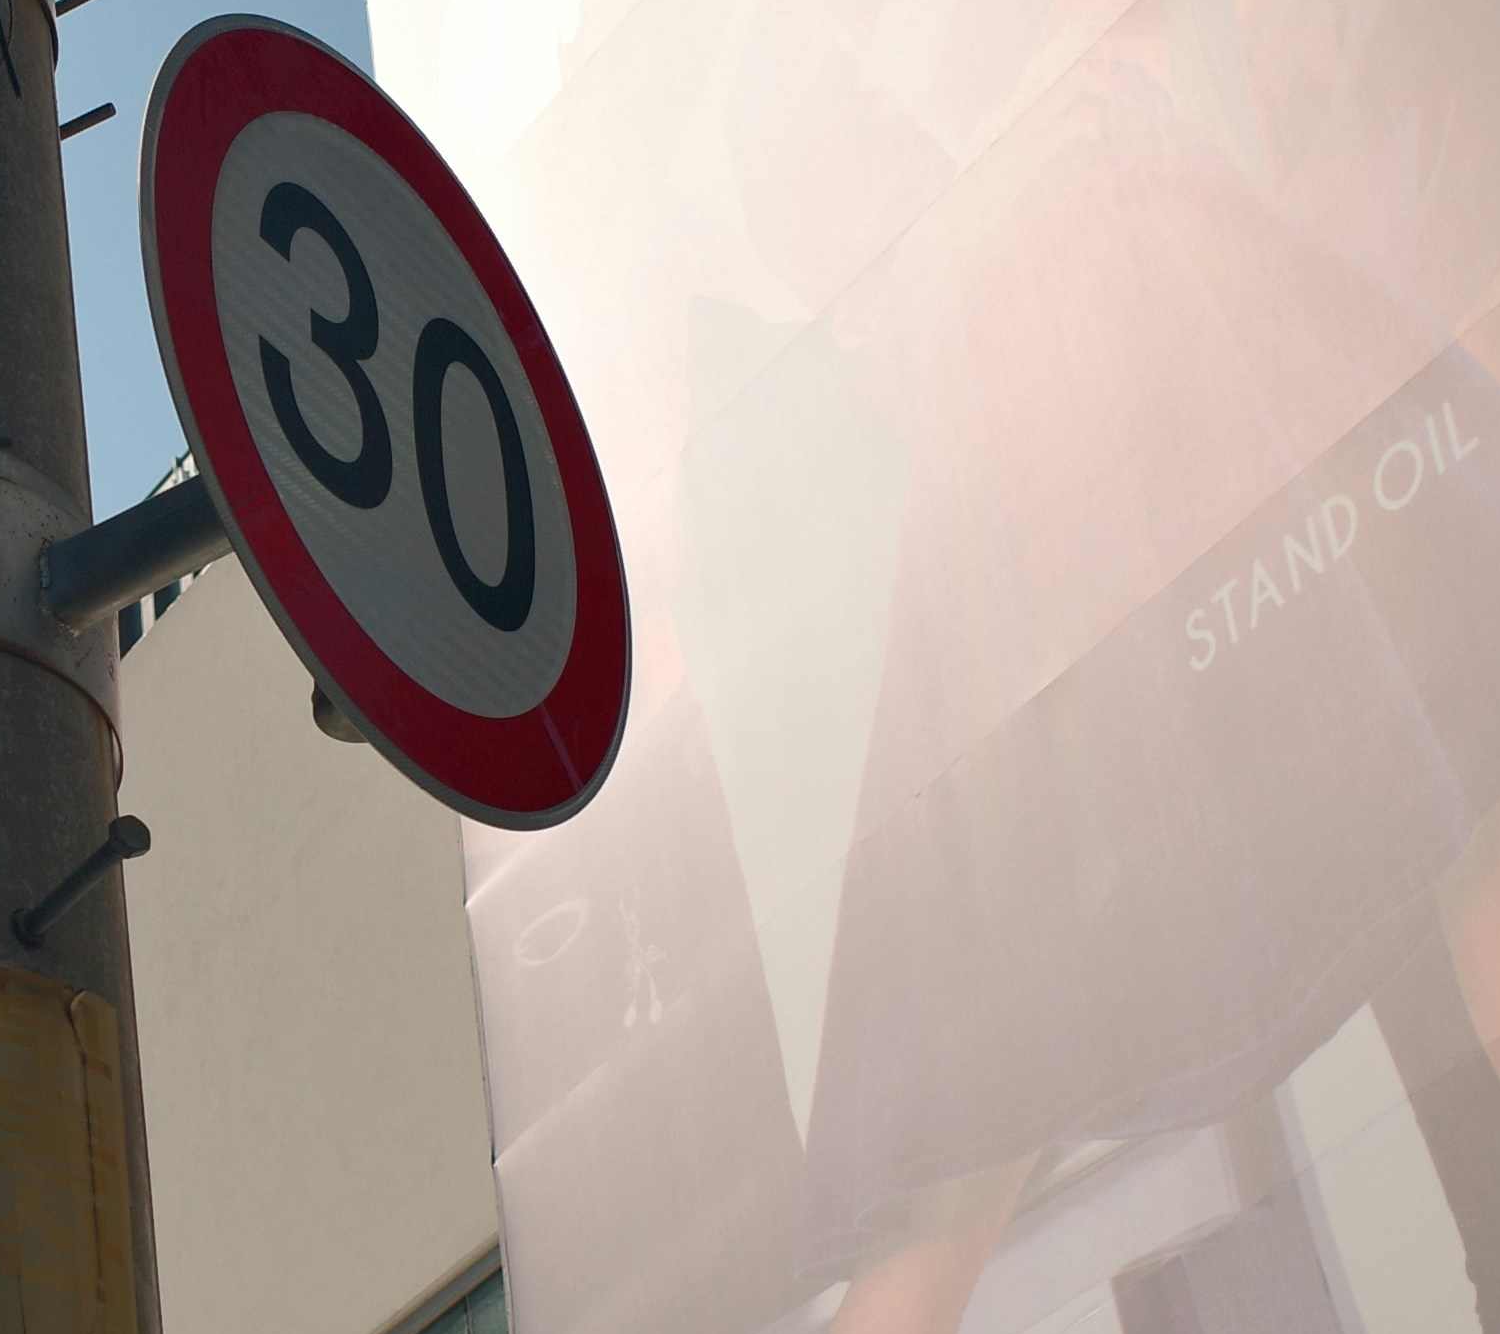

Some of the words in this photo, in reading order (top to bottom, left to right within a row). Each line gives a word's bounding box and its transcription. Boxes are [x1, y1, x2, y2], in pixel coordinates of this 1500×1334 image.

[258, 181, 536, 633] 30
[1185, 494, 1358, 671] STAND
[1373, 400, 1480, 512] OIL
